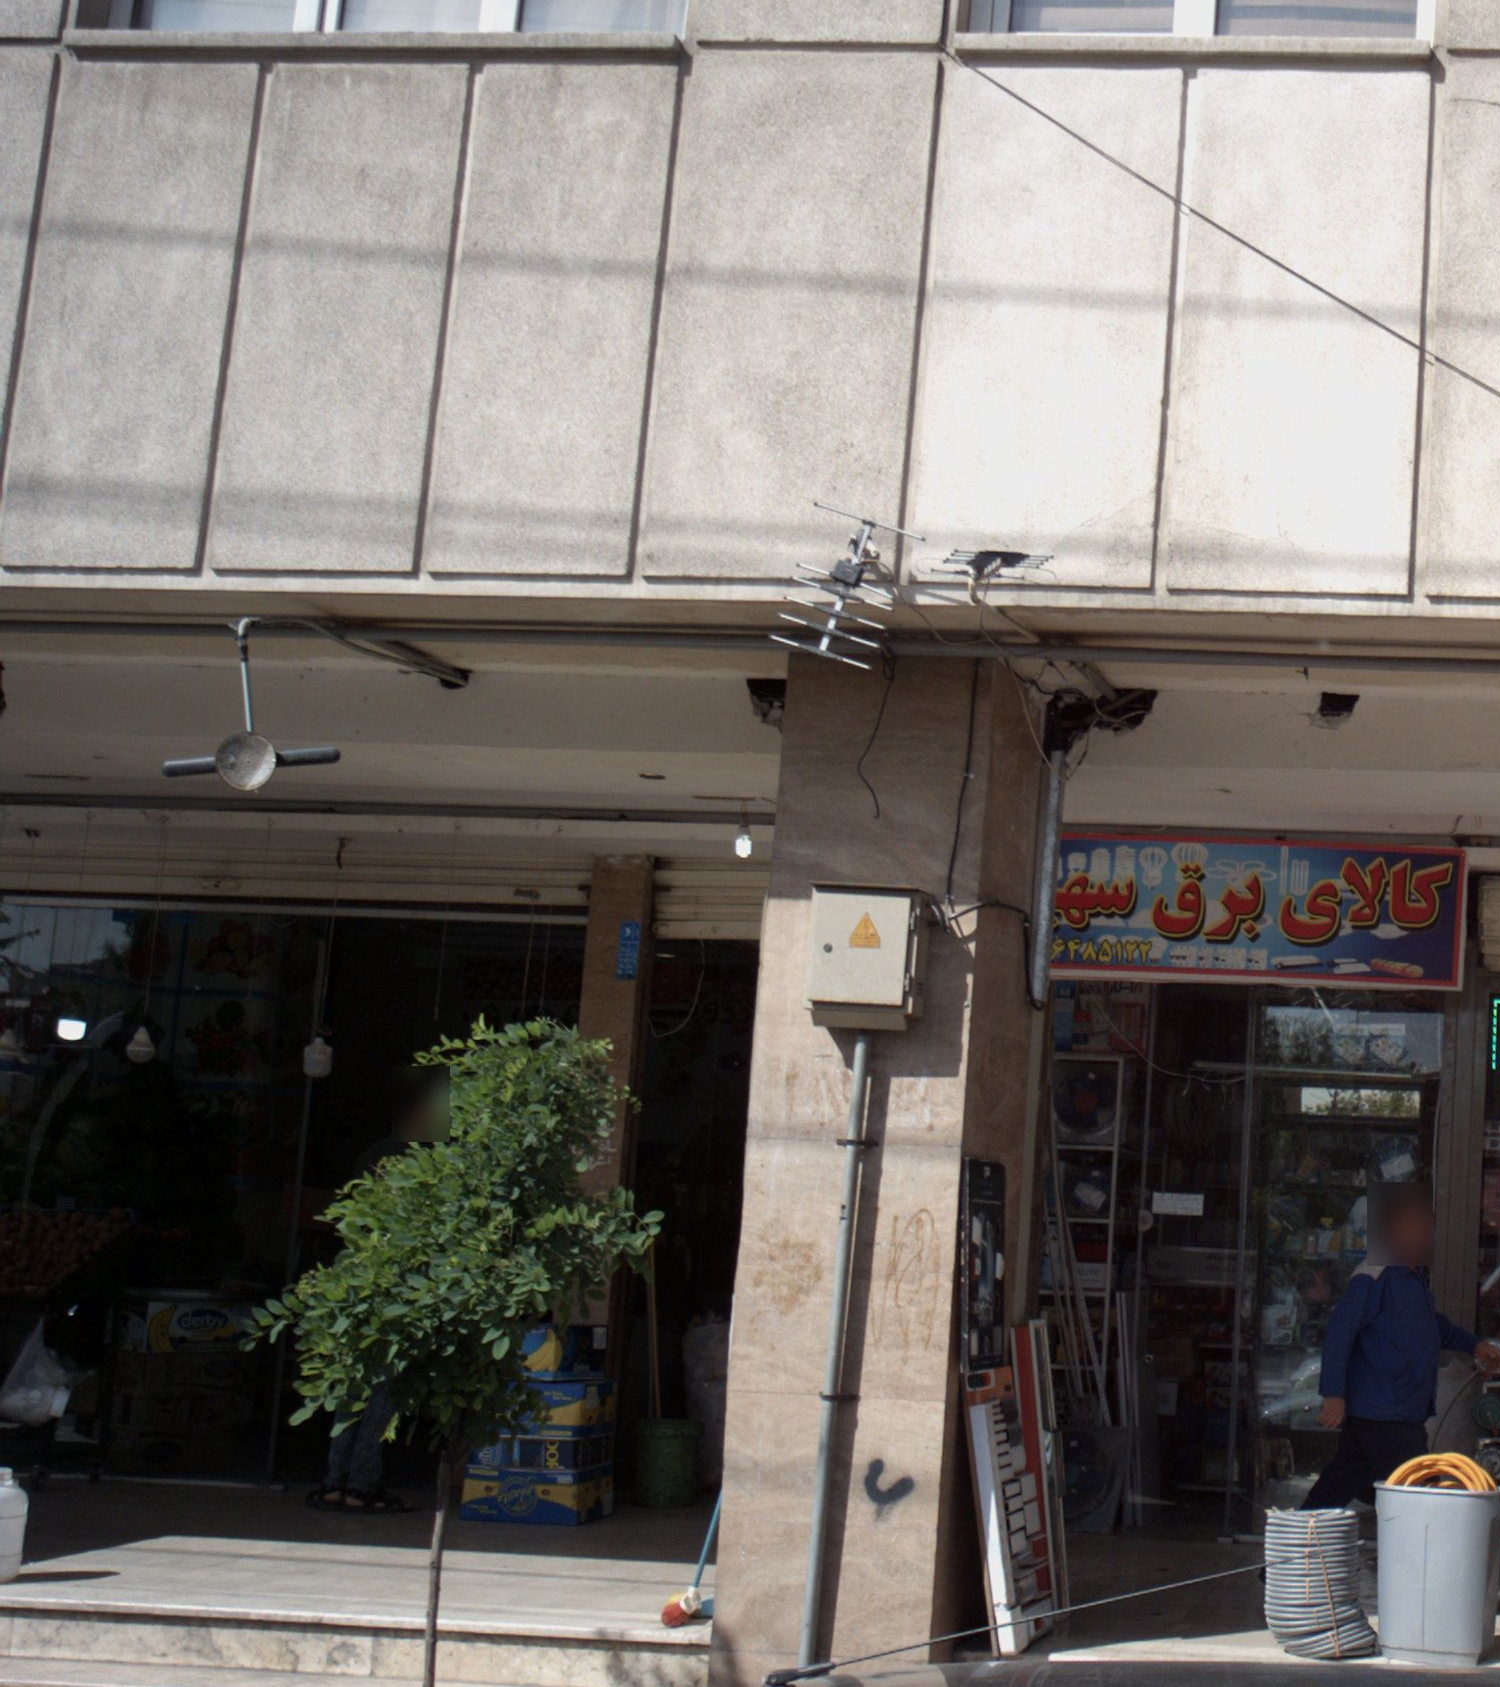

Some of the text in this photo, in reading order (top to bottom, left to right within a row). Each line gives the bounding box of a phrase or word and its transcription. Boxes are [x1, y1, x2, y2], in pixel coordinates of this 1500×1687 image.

[1053, 857, 1452, 943] کالای برق سه
[180, 1310, 226, 1330] derby
